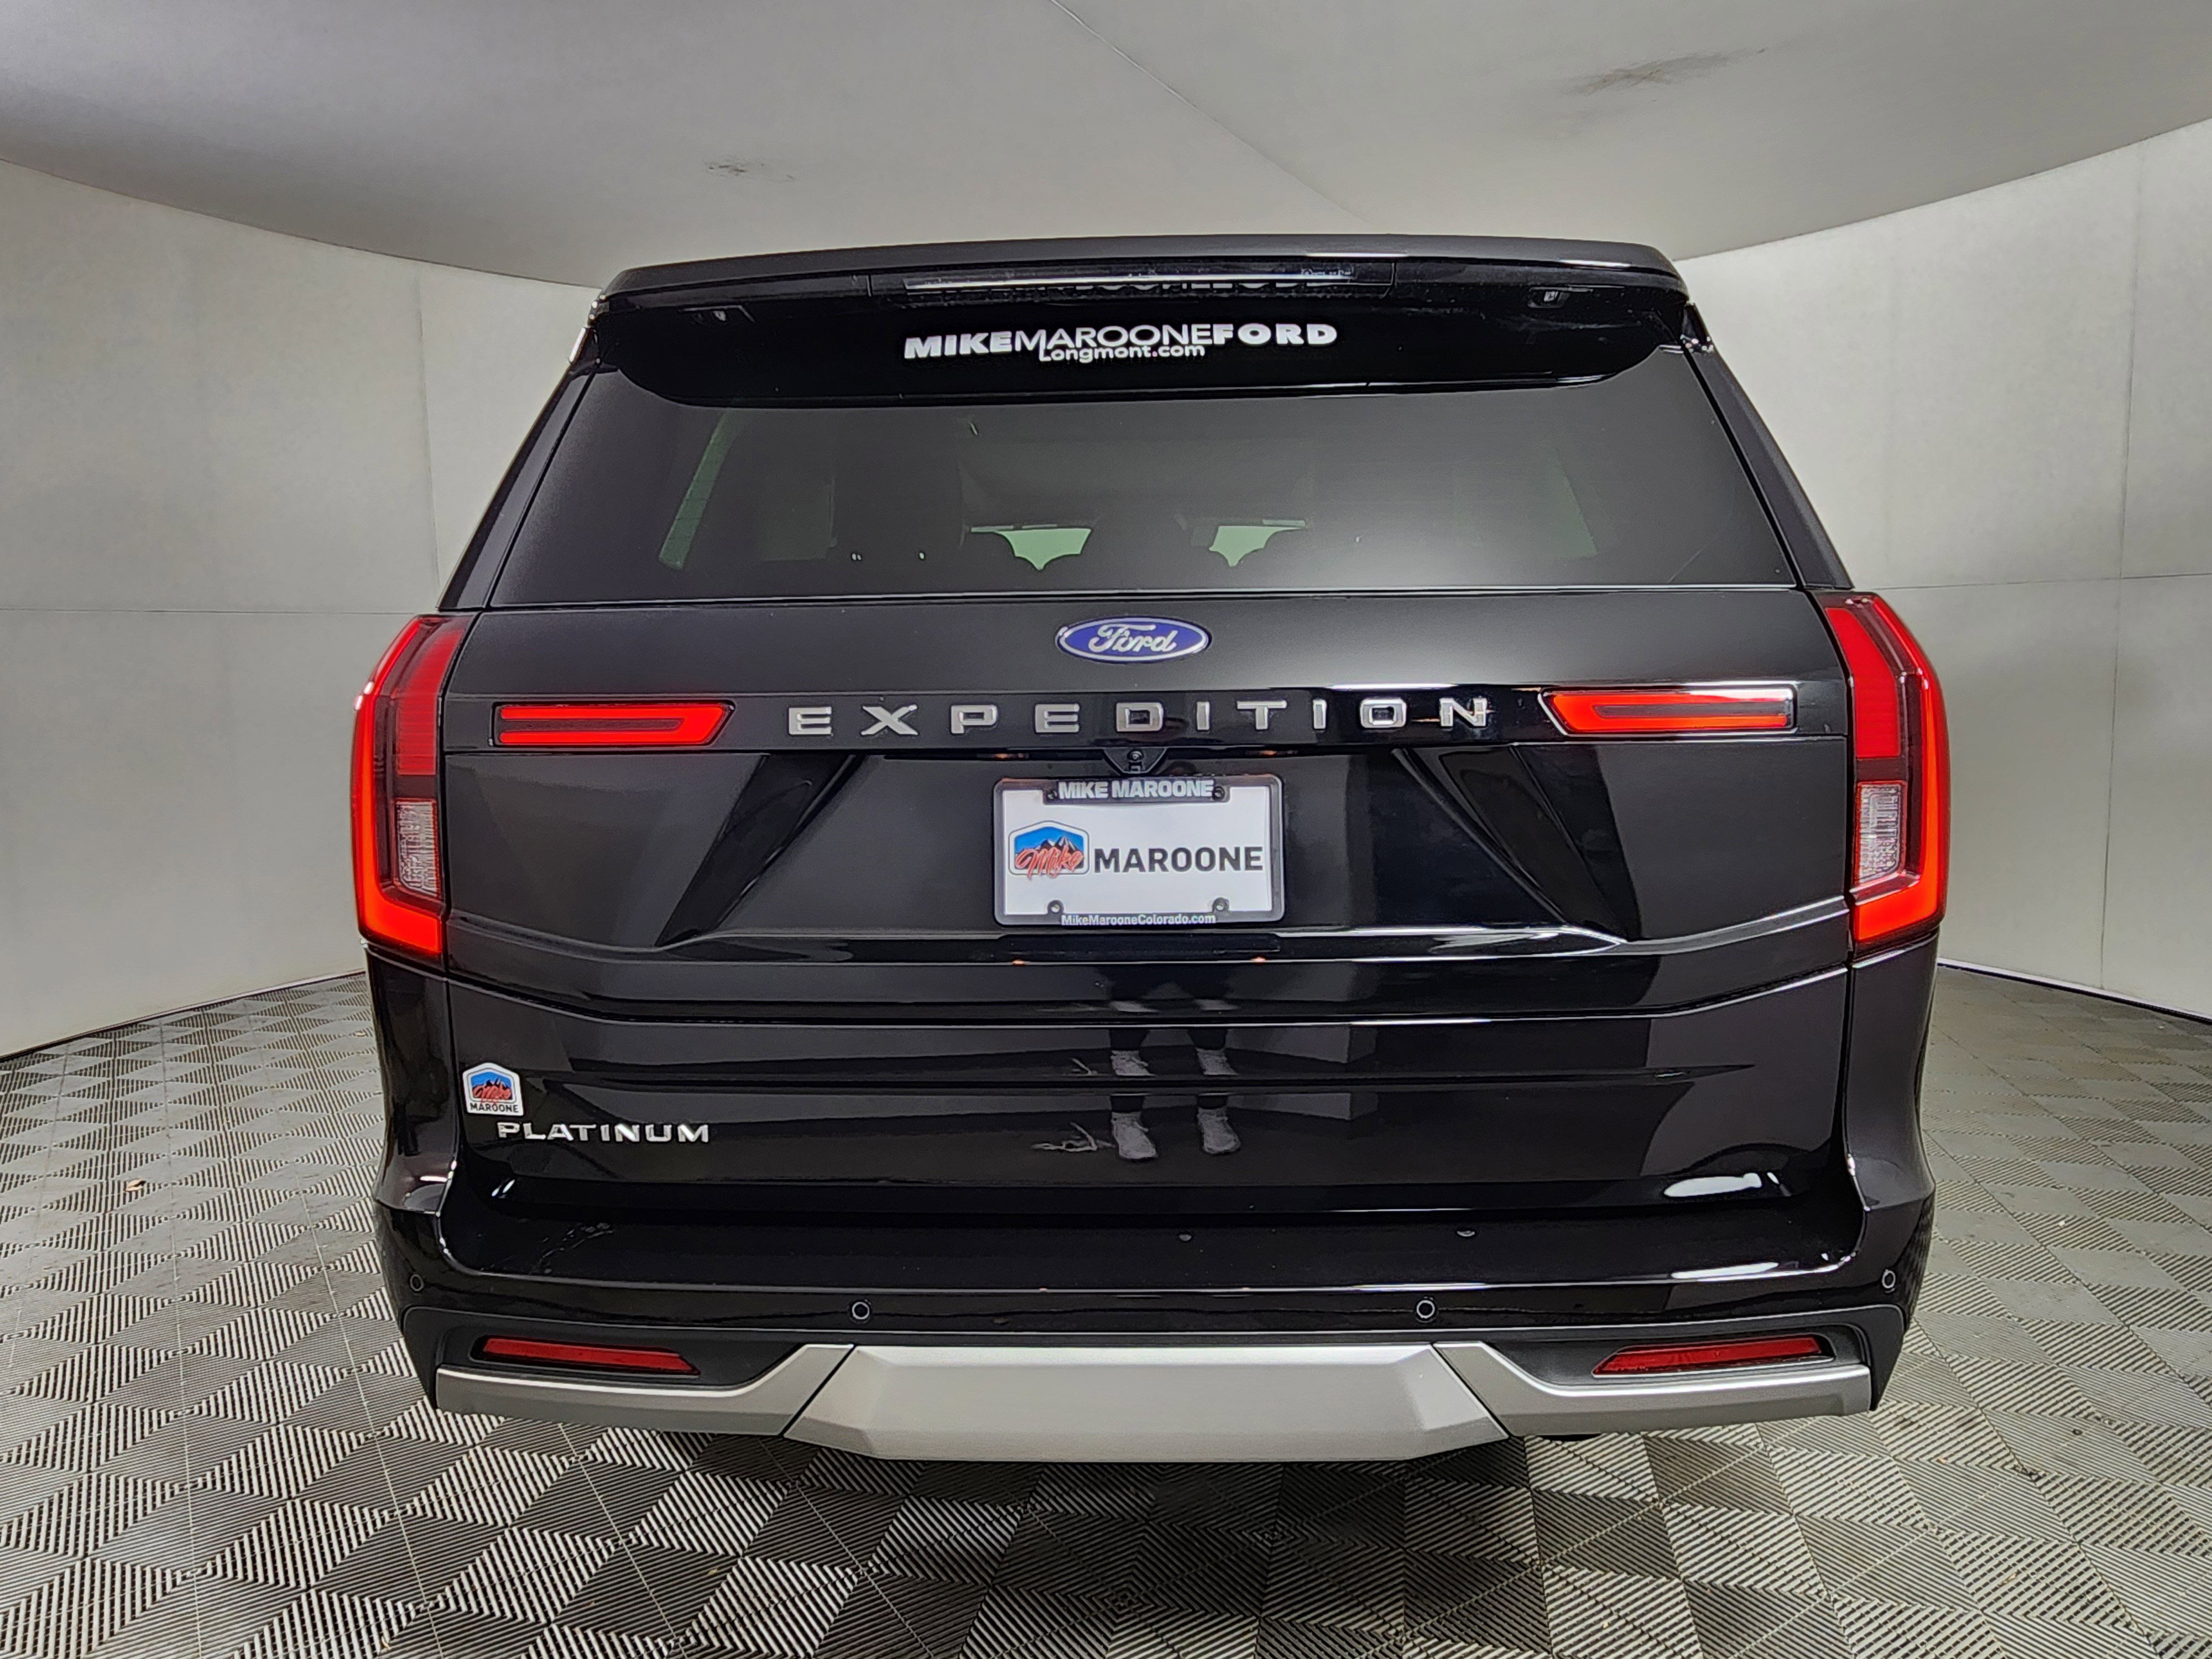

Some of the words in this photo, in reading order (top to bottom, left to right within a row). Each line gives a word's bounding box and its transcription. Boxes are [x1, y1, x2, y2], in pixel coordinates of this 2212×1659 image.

[1039, 344, 1206, 363] Longmont.com
[1088, 623, 1178, 652] Ford
[788, 697, 1488, 736] EXPEDITION
[1058, 780, 1108, 800] MIKE
[1111, 779, 1214, 798] MAROONE
[1016, 846, 1084, 879] Mike
[1094, 846, 1262, 873] MAROONE
[1061, 914, 1216, 925] MikeMarooneColorado.com
[470, 1102, 519, 1113] MAROONE
[497, 1122, 709, 1142] PLATINUM
